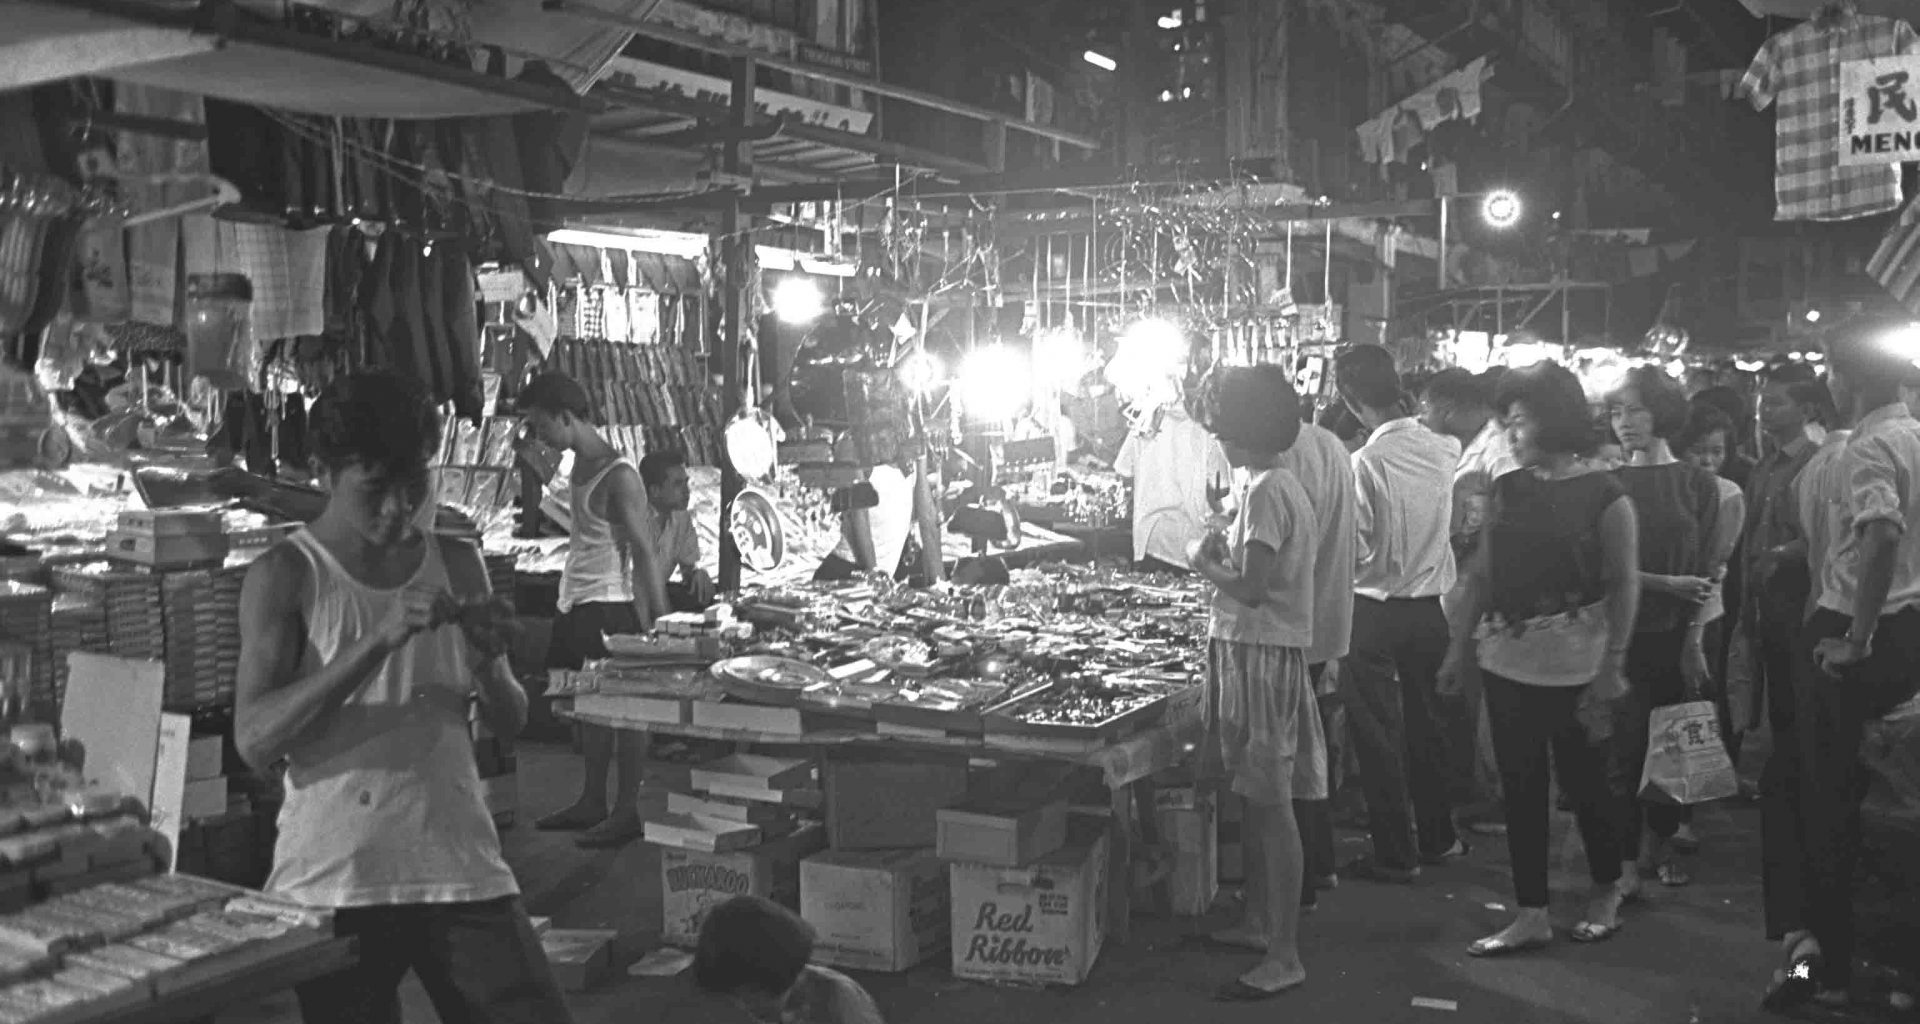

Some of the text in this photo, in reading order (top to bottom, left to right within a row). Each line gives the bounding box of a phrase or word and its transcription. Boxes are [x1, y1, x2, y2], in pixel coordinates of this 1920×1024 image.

[1867, 70, 1917, 124] 民
[973, 901, 1034, 932] Red
[965, 934, 1070, 965] Ribbon
